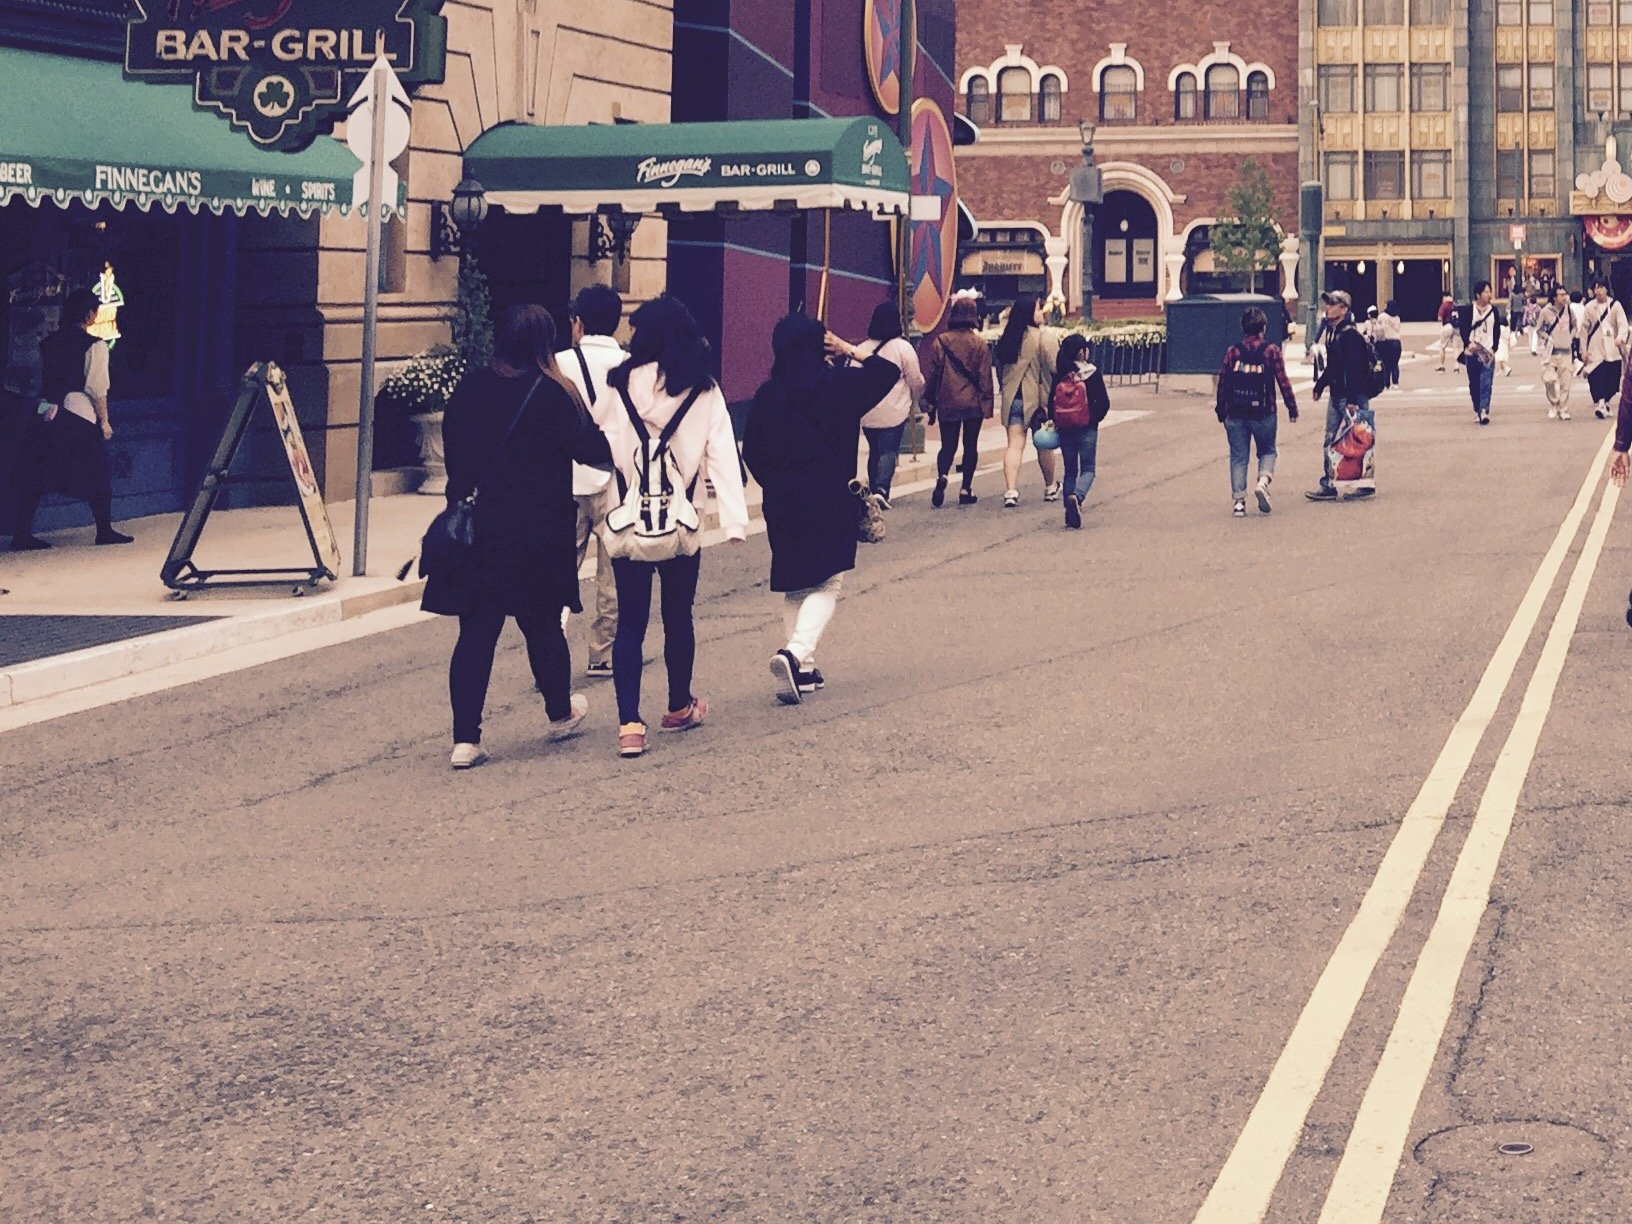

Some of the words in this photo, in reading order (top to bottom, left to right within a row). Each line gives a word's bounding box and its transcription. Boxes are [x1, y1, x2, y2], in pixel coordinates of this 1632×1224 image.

[0, 161, 33, 185] BEER
[95, 164, 201, 195] FINNEGAN'S
[252, 178, 277, 197] WINE
[301, 181, 335, 201] SPIRITS
